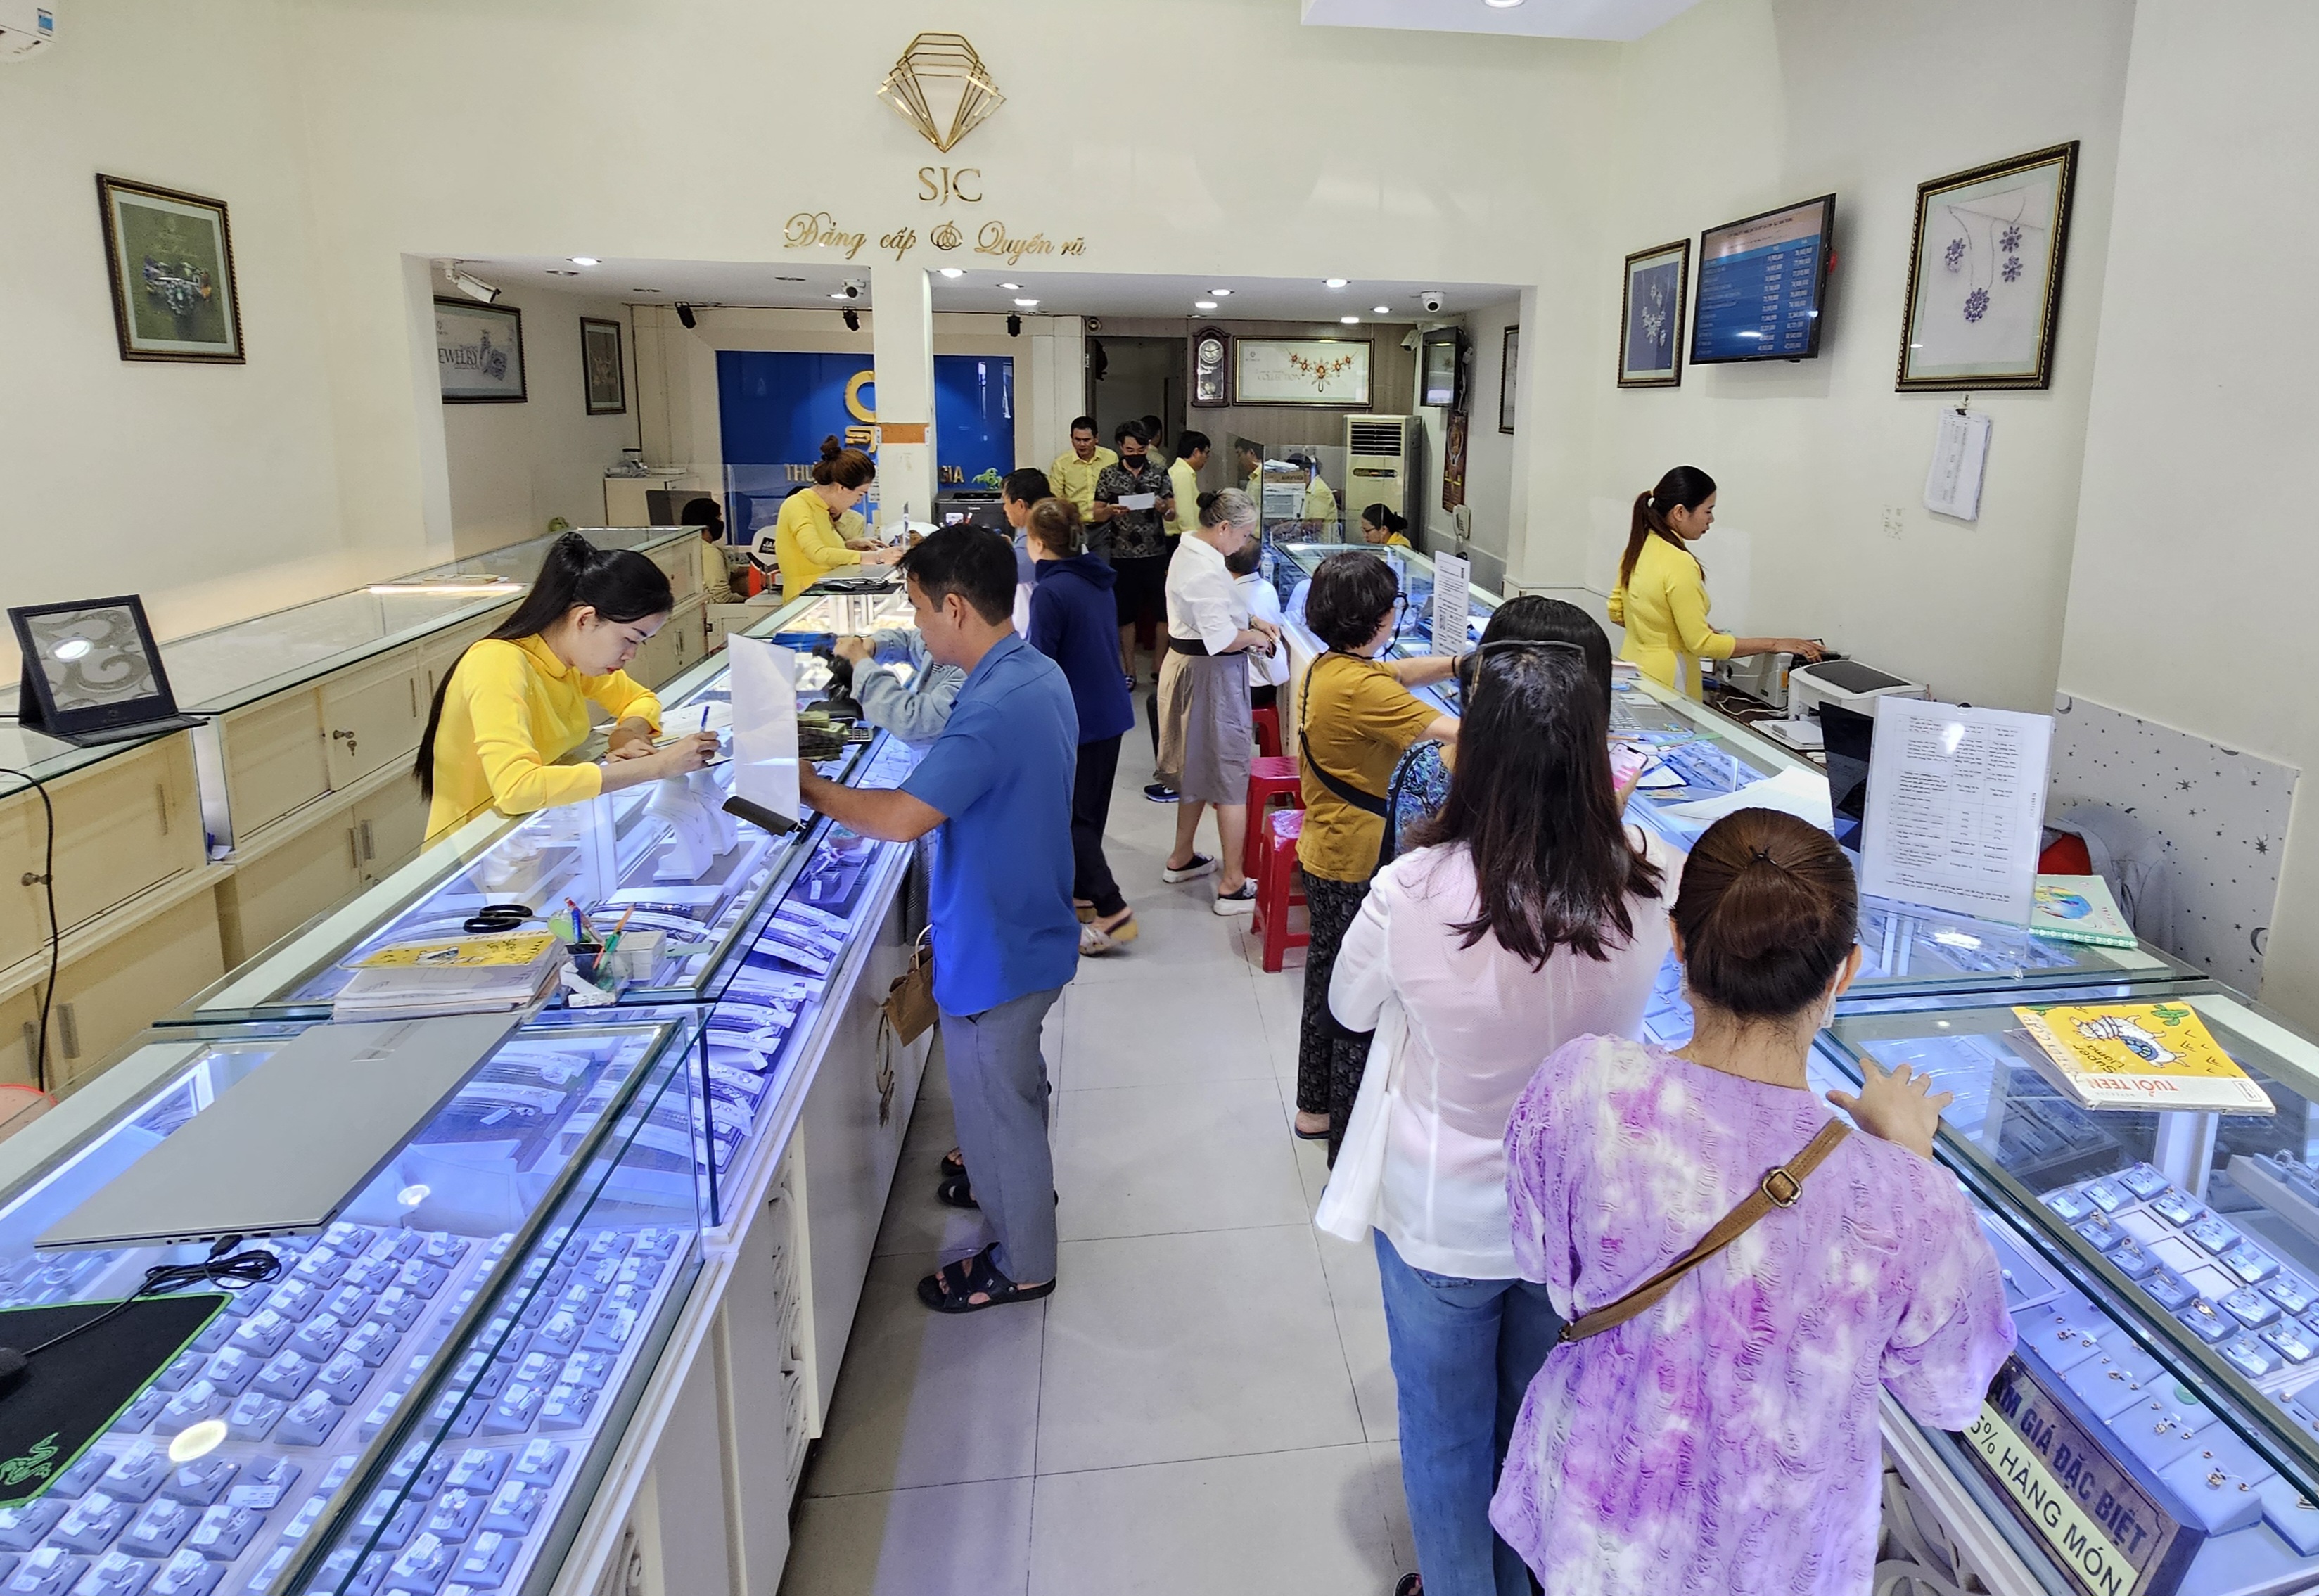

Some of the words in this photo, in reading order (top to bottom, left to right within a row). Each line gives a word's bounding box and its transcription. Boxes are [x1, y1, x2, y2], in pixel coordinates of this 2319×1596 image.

[918, 167, 983, 206] SJC
[880, 226, 916, 261] cấp
[2072, 1045, 2116, 1074] Super
[2086, 1078, 2132, 1090] TEEN
[2131, 1080, 2179, 1097] TUỔI
[2019, 1407, 2057, 1457] GIÁ
[2052, 1443, 2097, 1501] ĐẶC
[2094, 1488, 2148, 1555] BIỆT
[1999, 1447, 2062, 1528] HÀNG
[2062, 1522, 2123, 1596] MÓN
